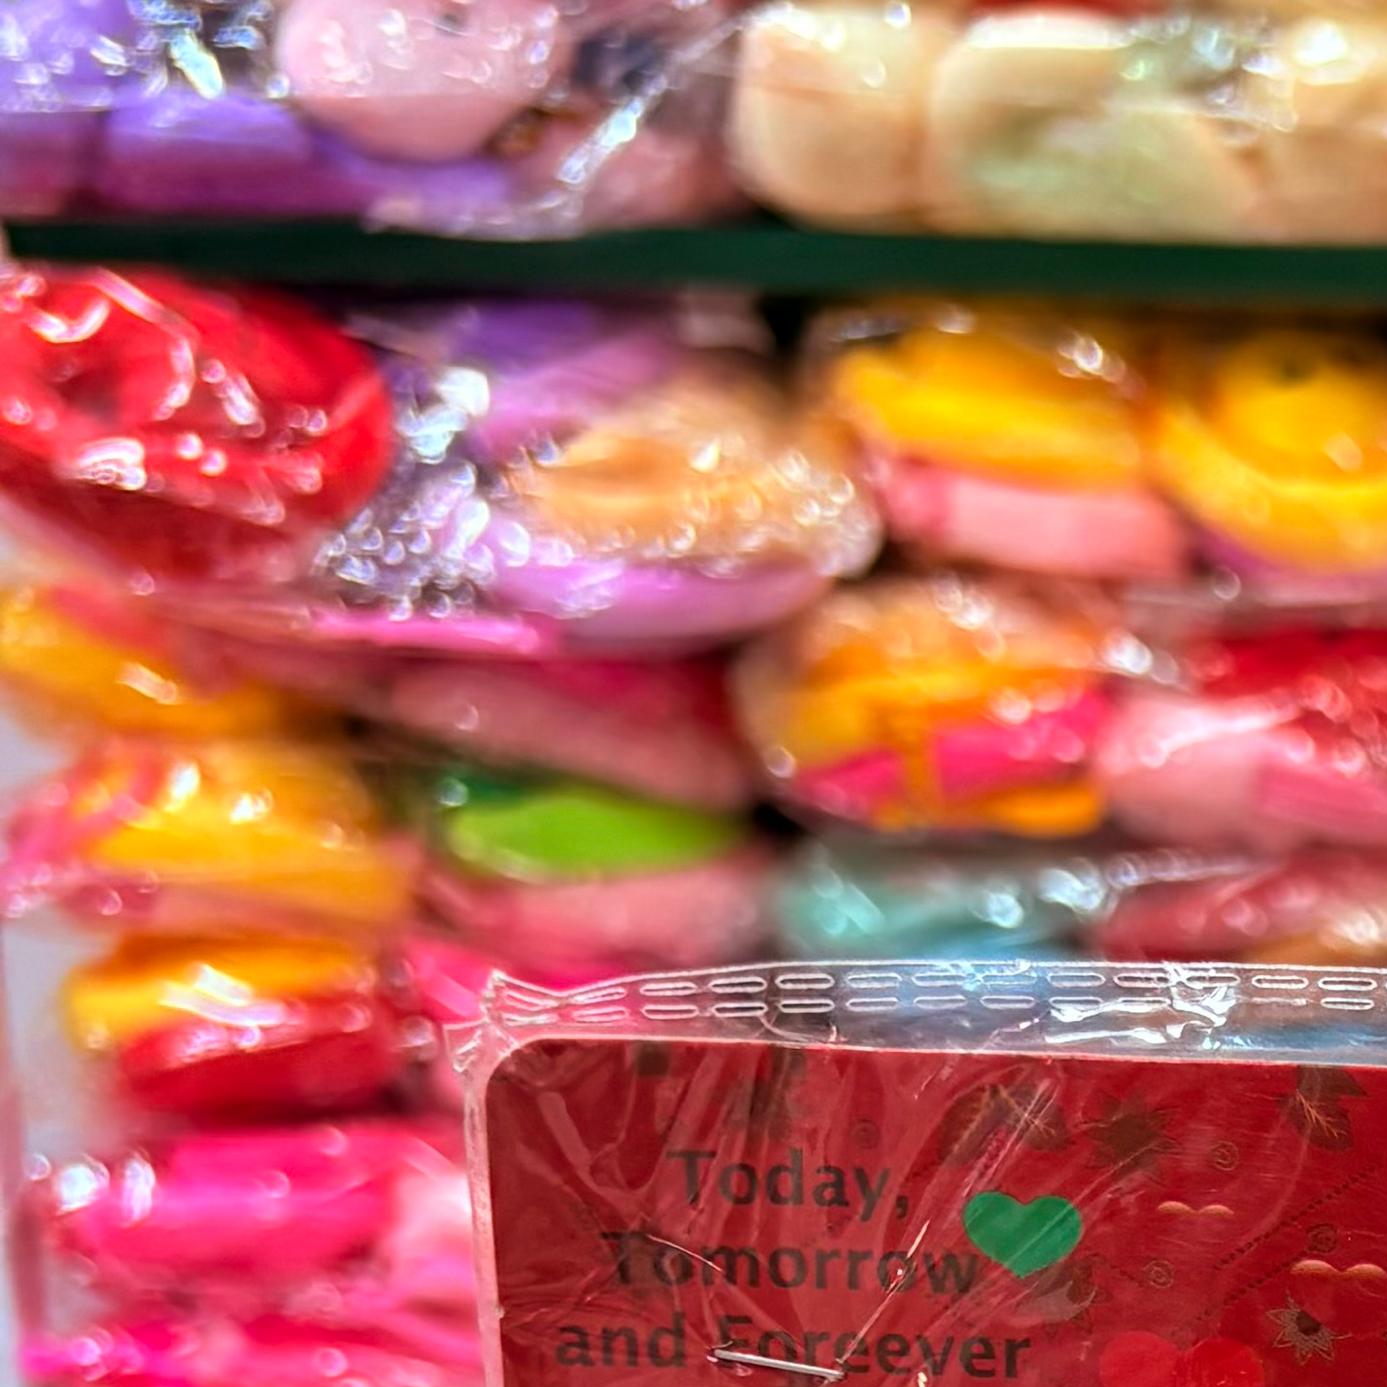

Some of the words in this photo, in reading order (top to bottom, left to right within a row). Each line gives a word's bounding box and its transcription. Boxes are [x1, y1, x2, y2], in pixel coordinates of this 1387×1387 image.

[666, 1148, 908, 1221] Today,
[601, 1230, 978, 1295] Tomorrow
[555, 1313, 687, 1368] and
